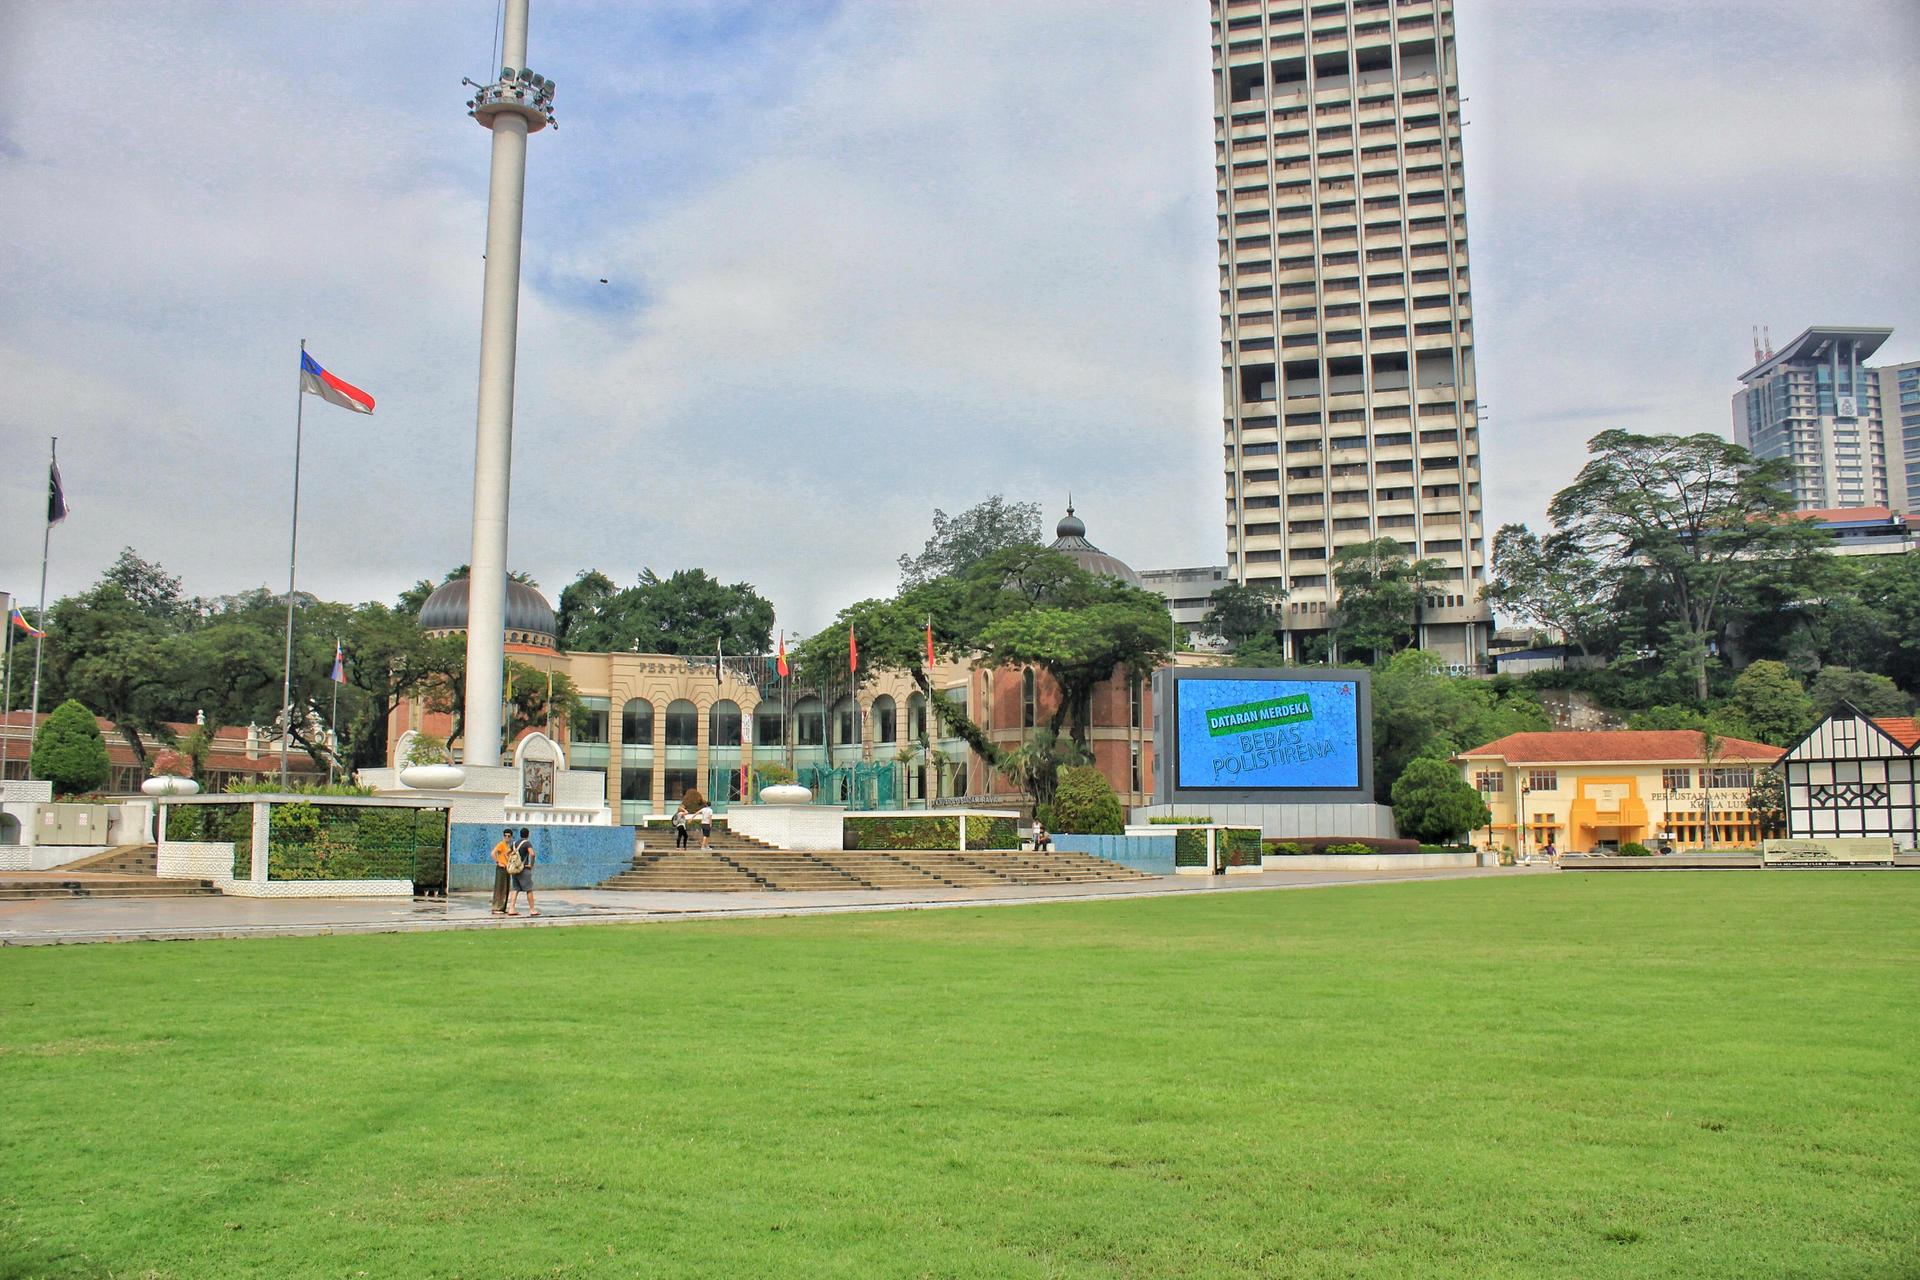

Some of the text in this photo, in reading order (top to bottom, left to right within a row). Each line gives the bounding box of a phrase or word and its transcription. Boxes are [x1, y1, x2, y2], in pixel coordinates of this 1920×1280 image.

[1211, 702, 1310, 729] DATARAN MERDEKA
[1240, 726, 1302, 753] BEBAS
[1212, 739, 1336, 776] POLISTIRENA
